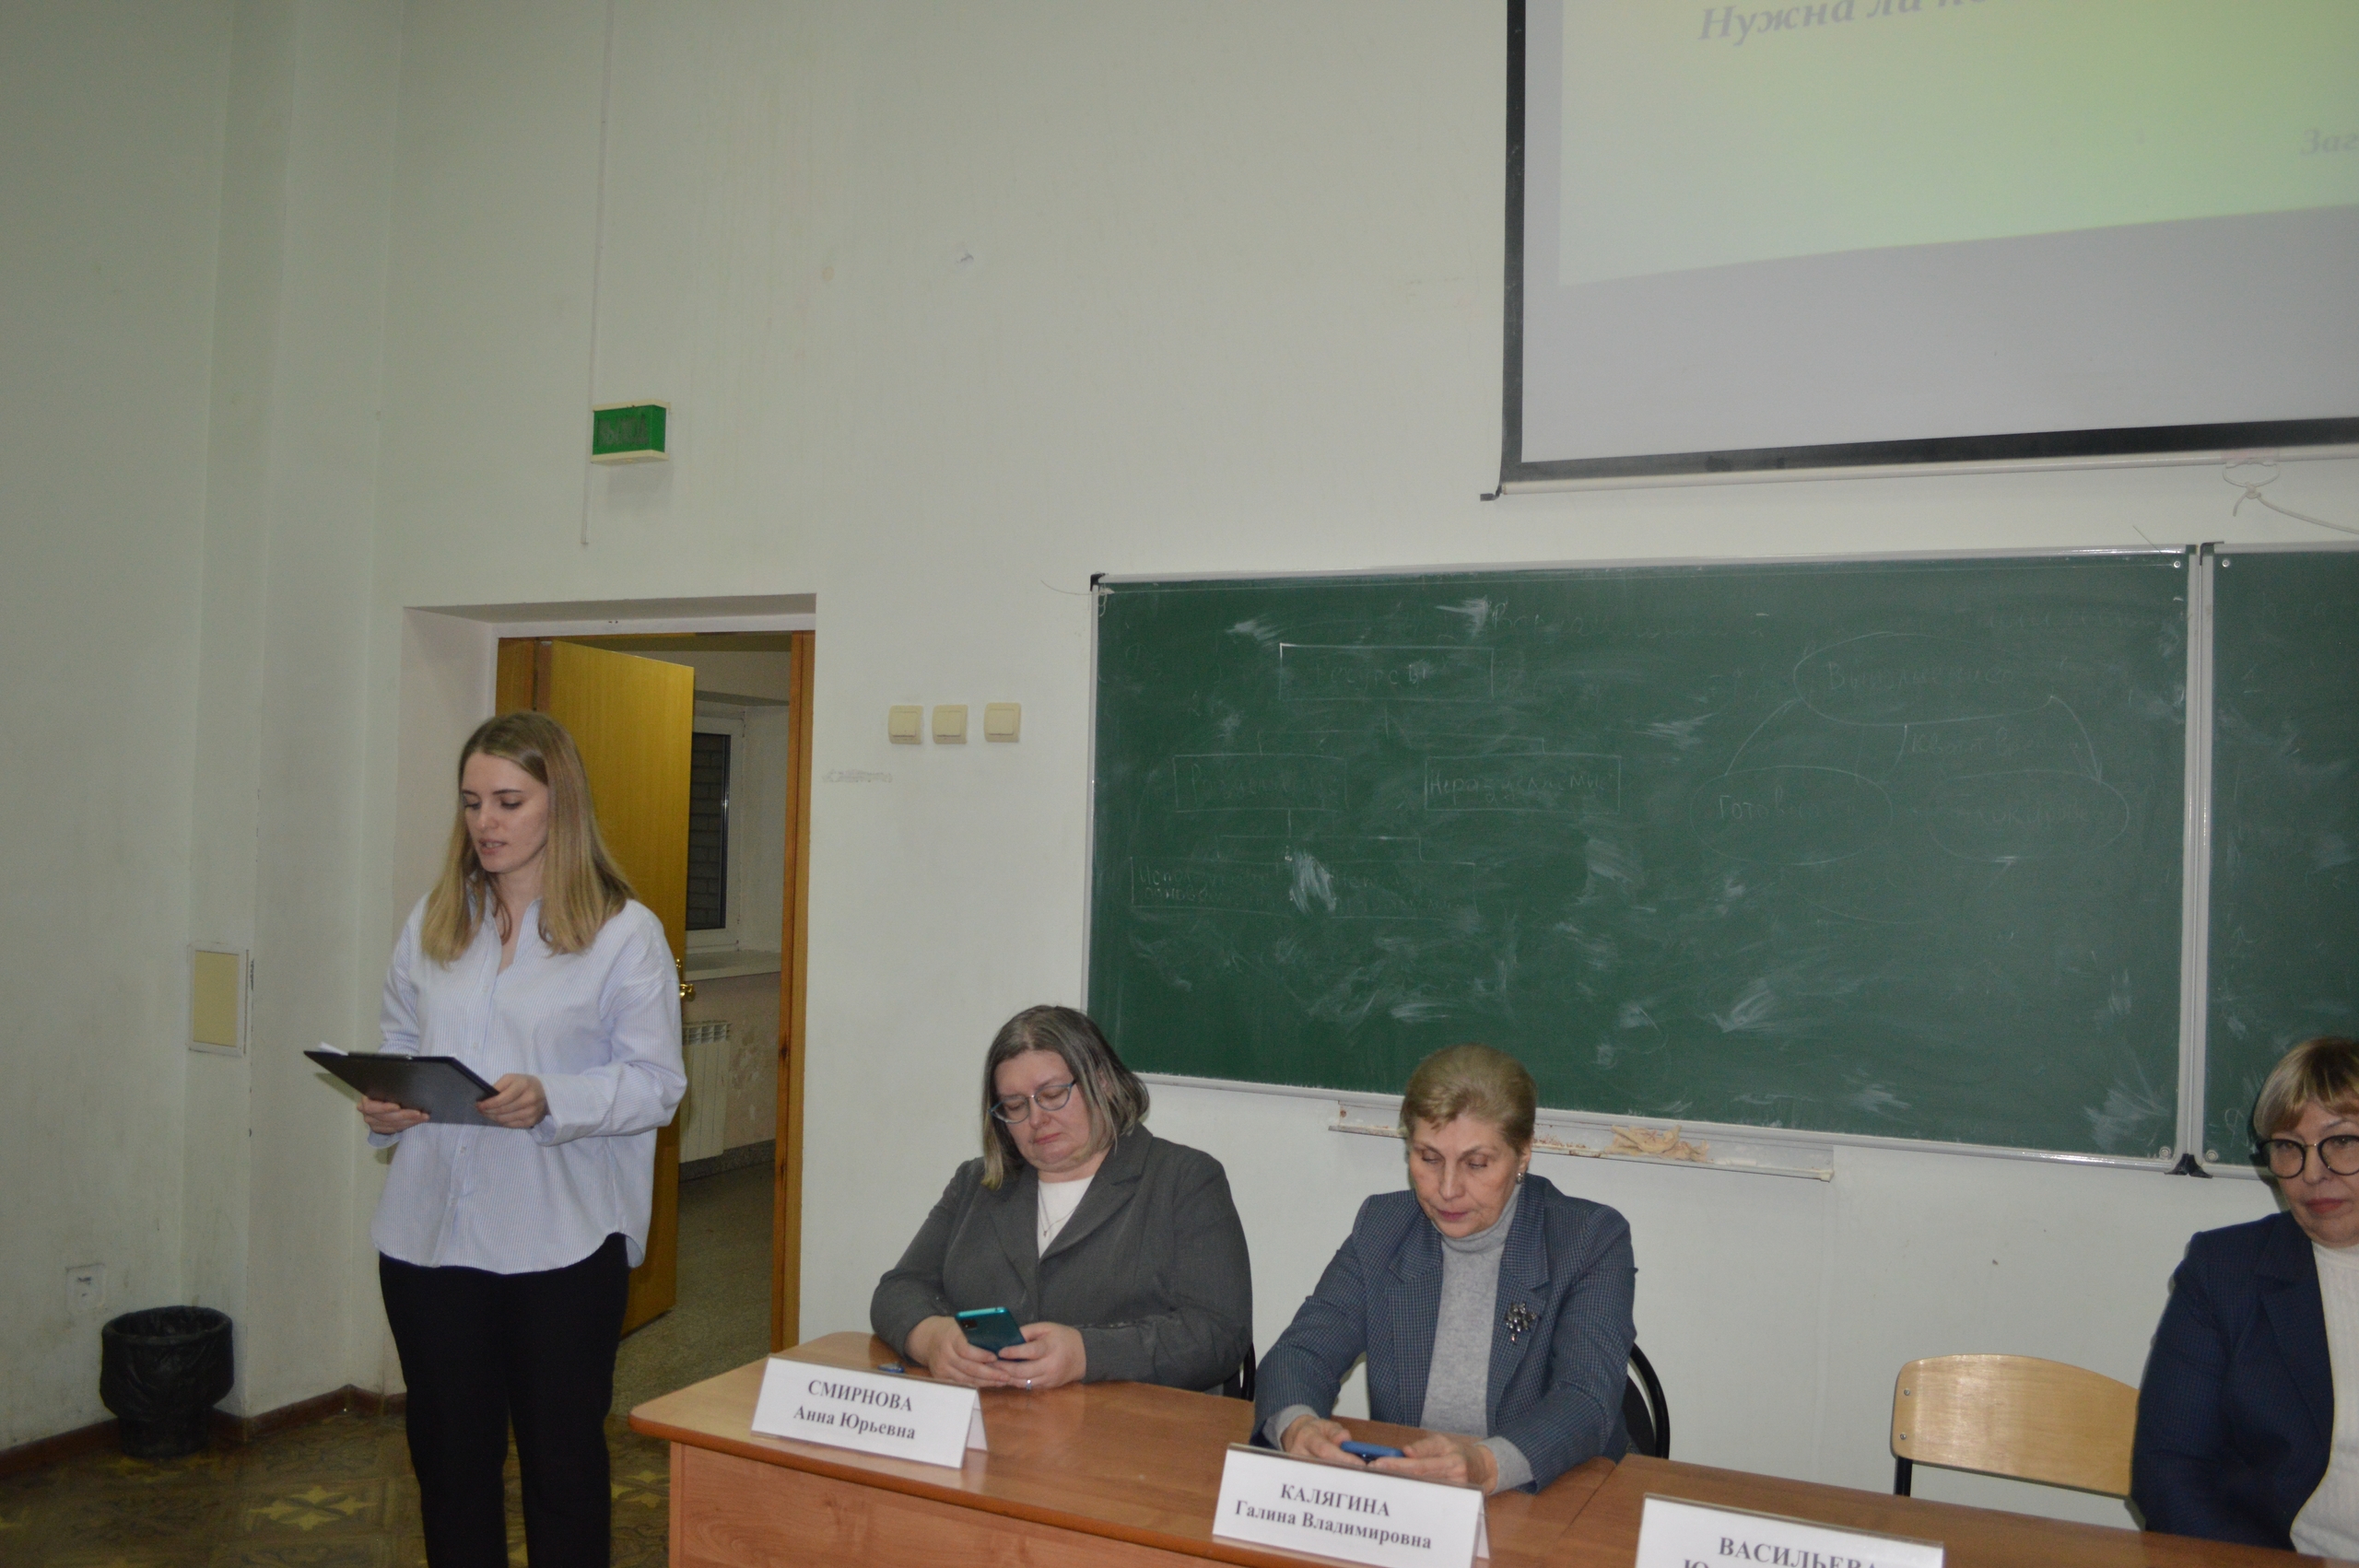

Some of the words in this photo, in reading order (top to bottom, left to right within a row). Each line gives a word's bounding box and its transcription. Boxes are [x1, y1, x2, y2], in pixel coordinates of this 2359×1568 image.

[1697, 0, 1855, 46] Нужна
[807, 1379, 912, 1412] СМИРНОВА
[792, 1406, 835, 1425] Анна
[839, 1412, 916, 1440] Юрьевна
[1280, 1484, 1390, 1517] КАЛЯГИНА
[1235, 1501, 1297, 1526] Галина
[1301, 1512, 1432, 1550] Владимировна
